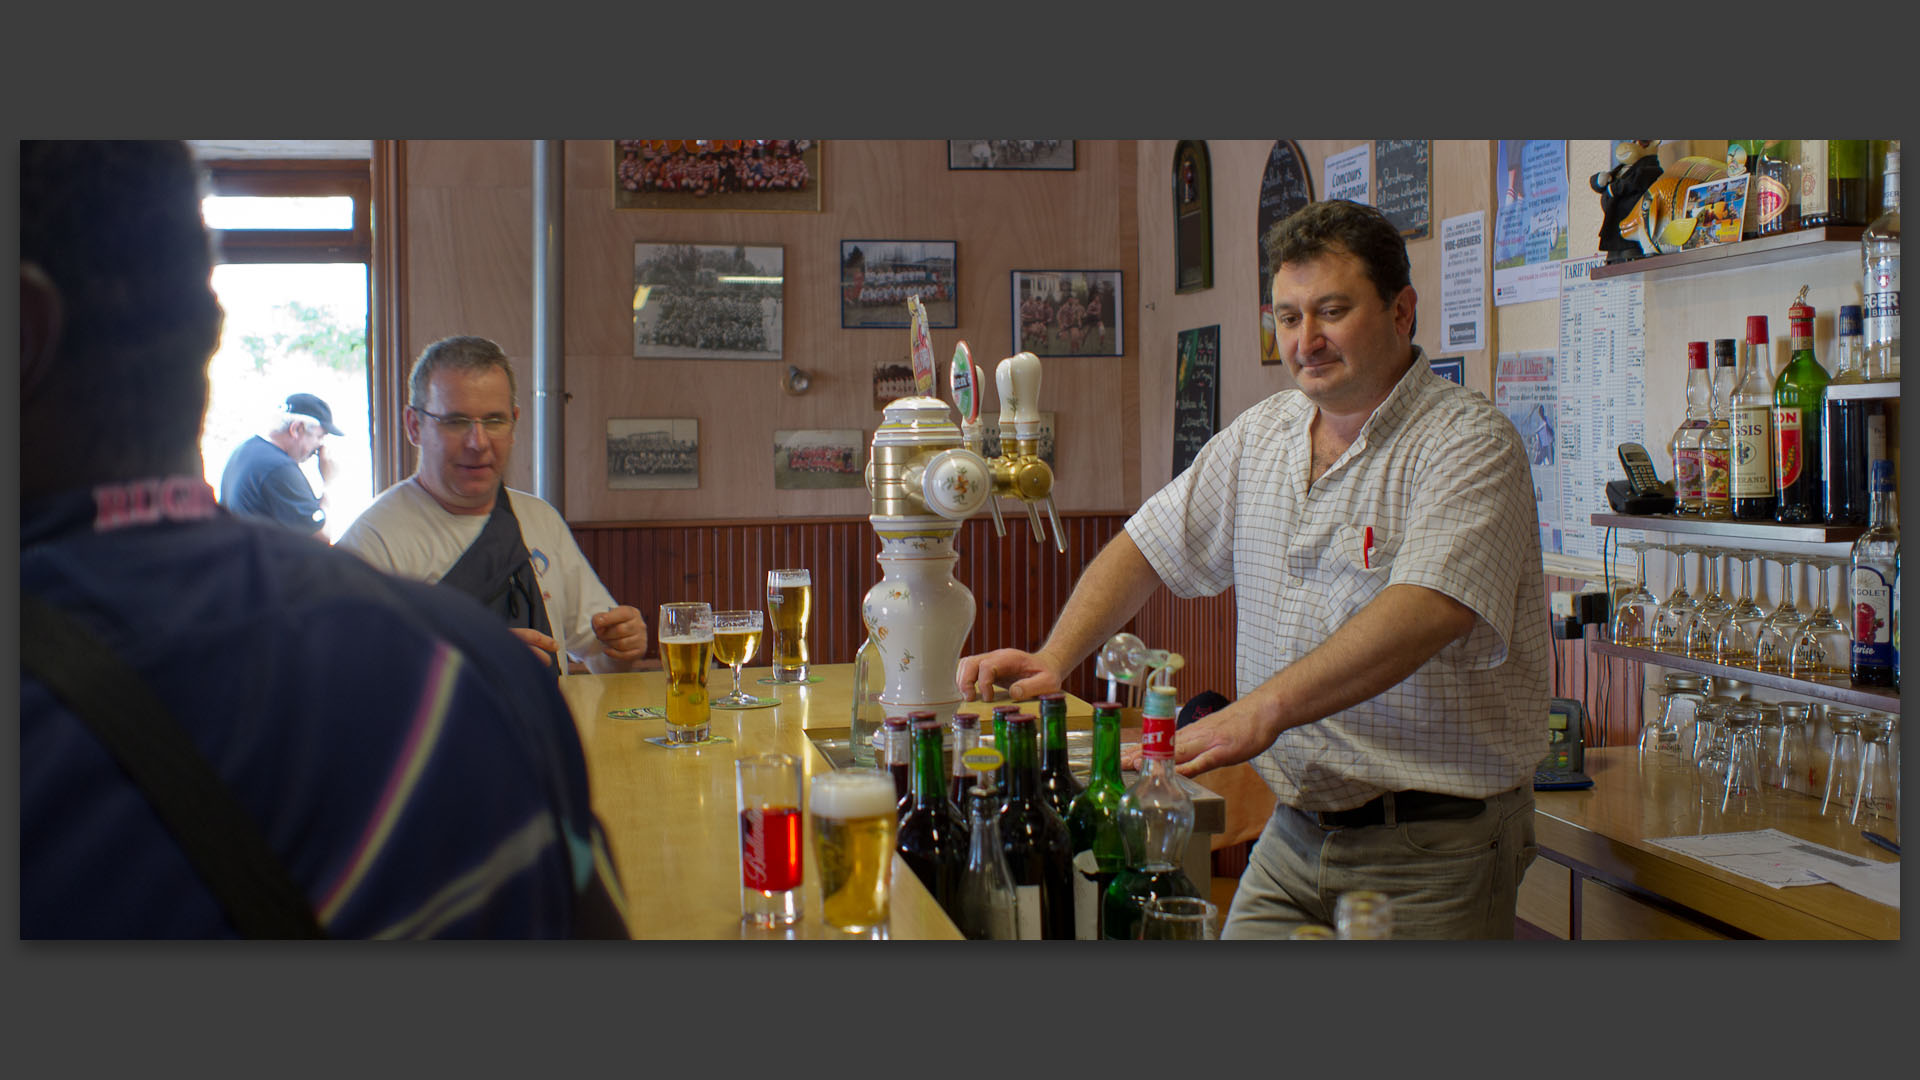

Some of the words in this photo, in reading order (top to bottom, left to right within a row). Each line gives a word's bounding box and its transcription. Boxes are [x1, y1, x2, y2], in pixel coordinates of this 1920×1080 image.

[1332, 168, 1362, 188] Concours
[1444, 234, 1482, 250] VIDE-GRENIERS
[1565, 262, 1584, 279] TARIF
[1872, 307, 1900, 317] Blanc
[1523, 359, 1543, 375] Libre
[1852, 588, 1887, 597] GOLET
